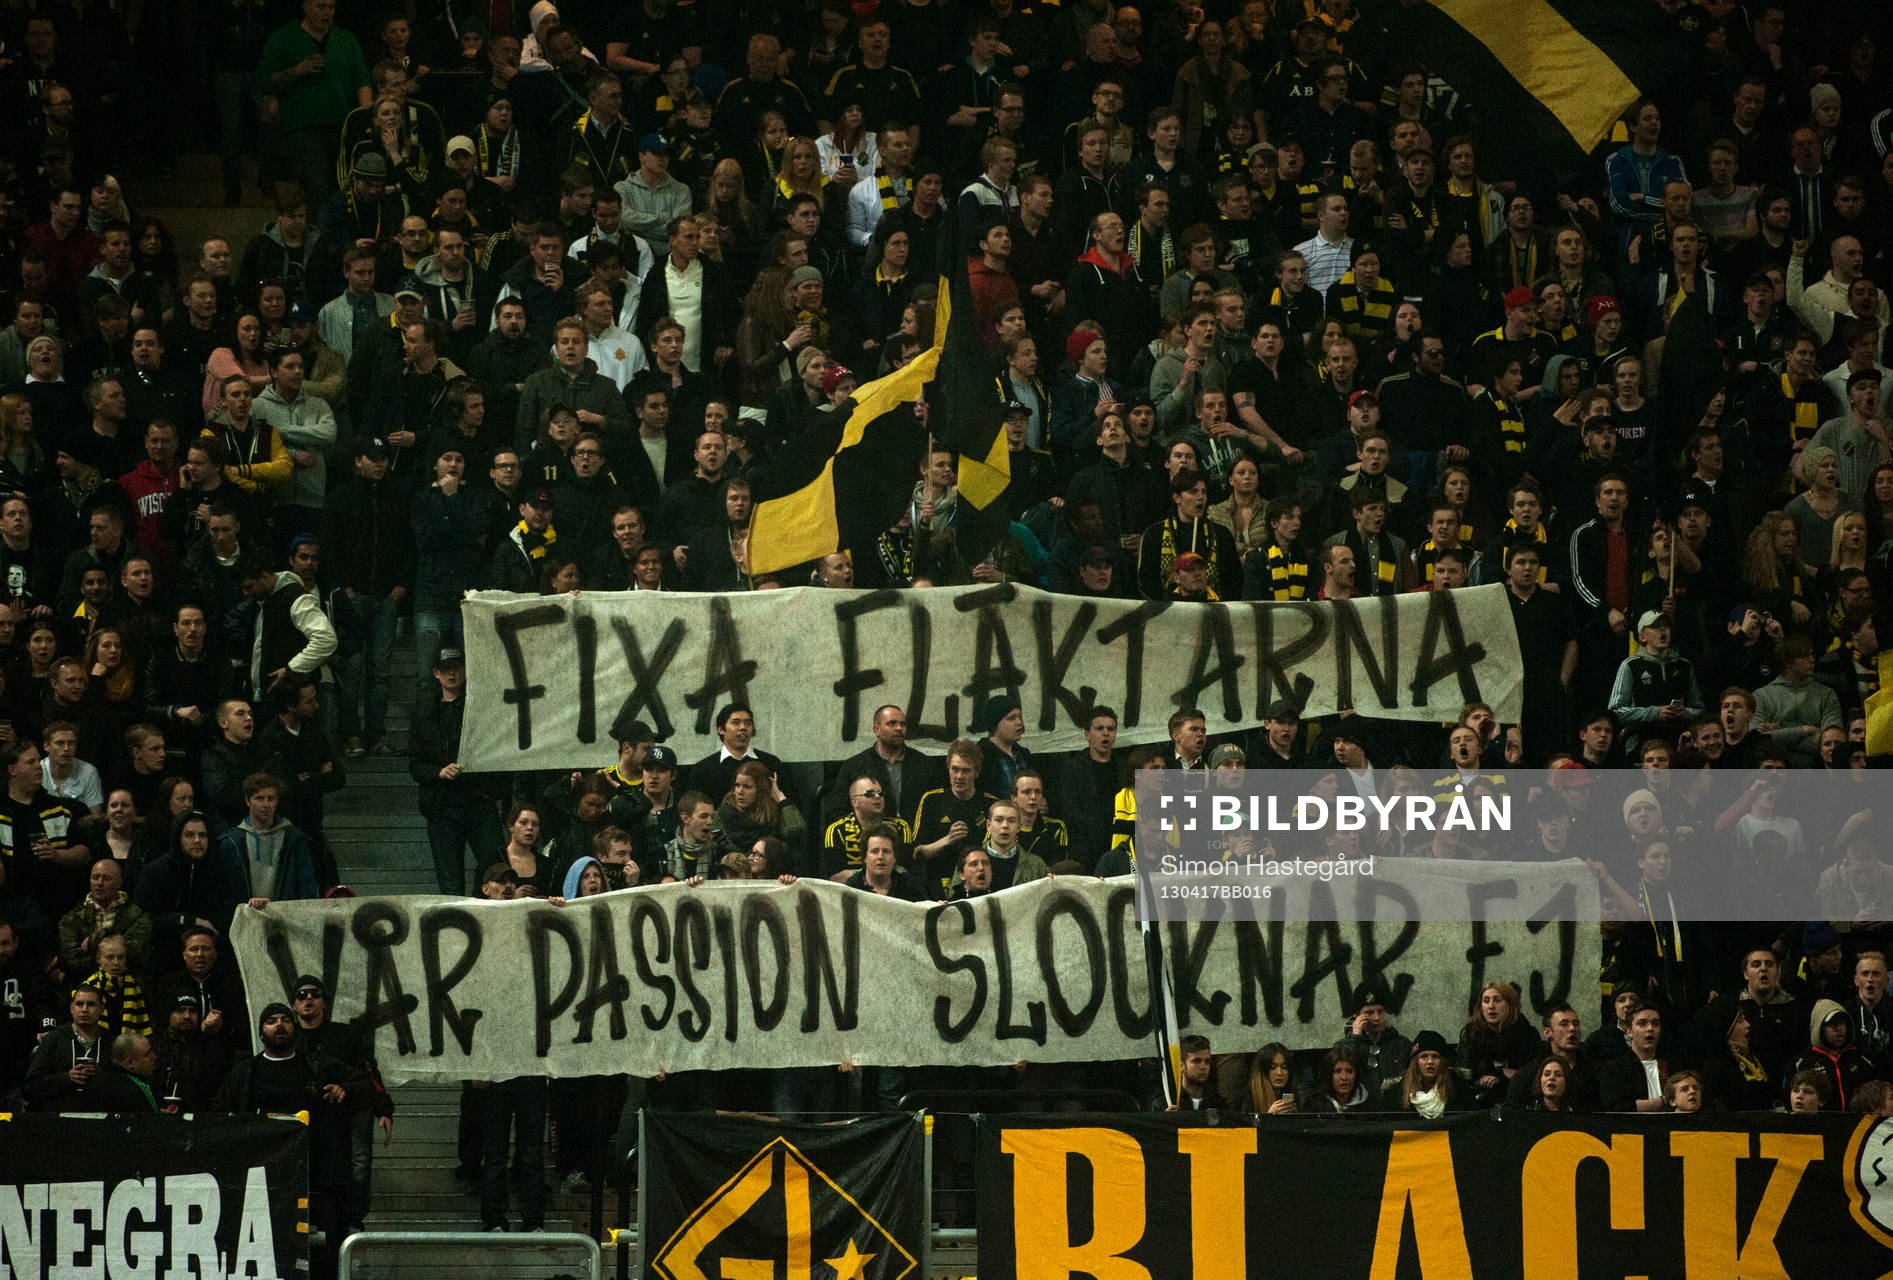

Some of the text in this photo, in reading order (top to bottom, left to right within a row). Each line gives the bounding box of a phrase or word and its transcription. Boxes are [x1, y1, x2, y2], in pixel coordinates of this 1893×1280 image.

[543, 465, 558, 481] 11
[494, 595, 758, 750] FIXA
[265, 902, 483, 1057] VÅR
[526, 886, 861, 1058] PASSION
[924, 877, 1420, 1046] SLOCKNAR
[0, 1166, 286, 1280] NEGRA
